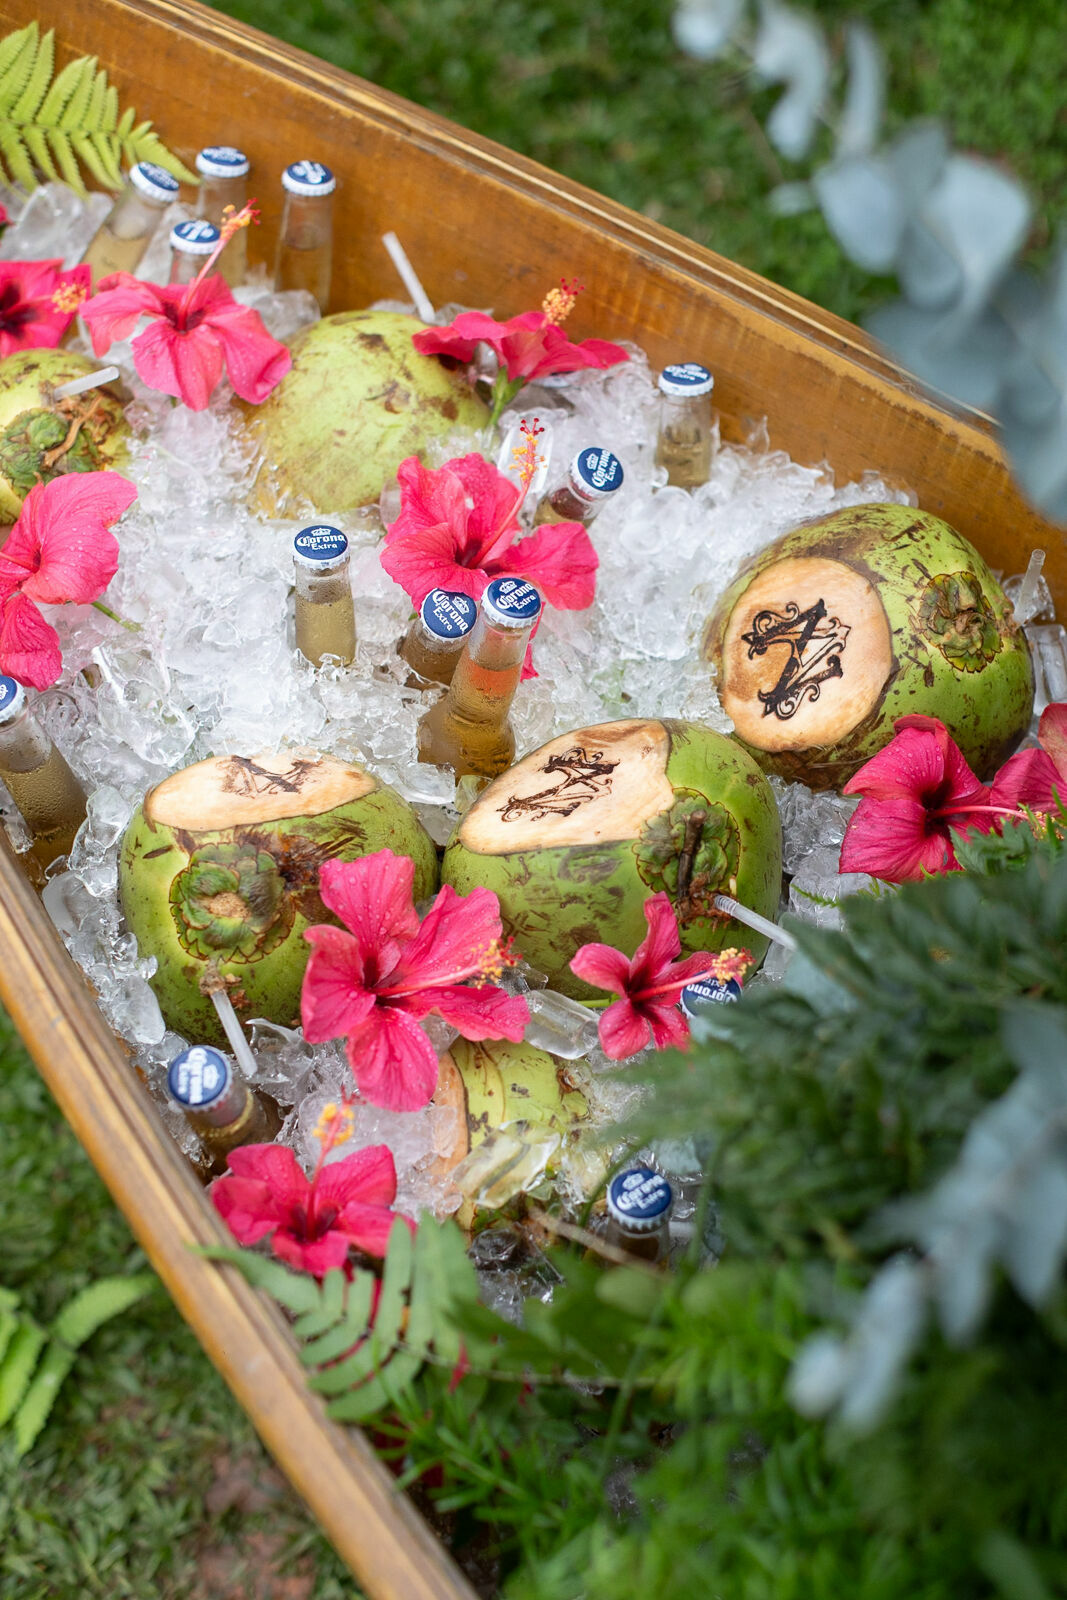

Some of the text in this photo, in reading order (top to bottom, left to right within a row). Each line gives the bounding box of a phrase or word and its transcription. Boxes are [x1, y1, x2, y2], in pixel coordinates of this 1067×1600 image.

[592, 449, 612, 487] Corona
[604, 461, 618, 481] Extra
[297, 535, 346, 547] Corona
[496, 583, 534, 609] Corona
[514, 594, 536, 610] Extra
[432, 591, 469, 634] Corona
[433, 607, 453, 631] Extra
